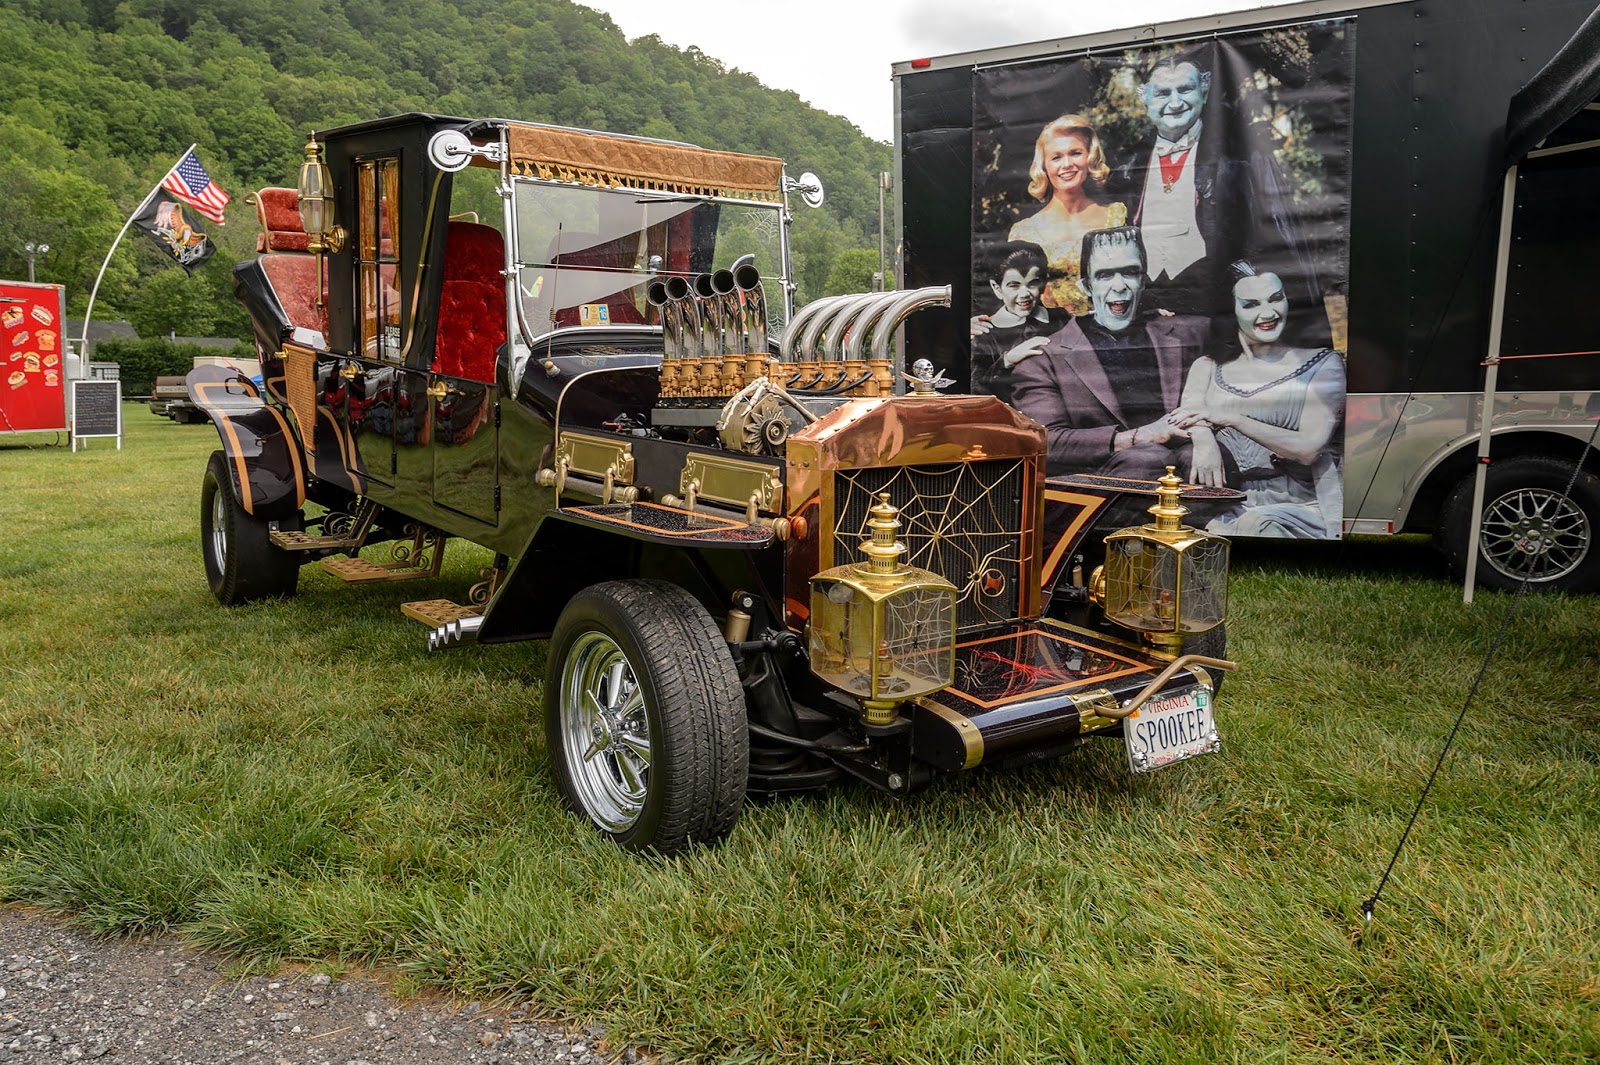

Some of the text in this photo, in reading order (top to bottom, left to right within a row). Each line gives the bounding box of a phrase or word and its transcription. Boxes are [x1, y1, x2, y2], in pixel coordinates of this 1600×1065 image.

[385, 326, 401, 338] PLEASE
[1148, 695, 1190, 714] VIRGINIA
[1136, 708, 1206, 754] SPOOKEE
